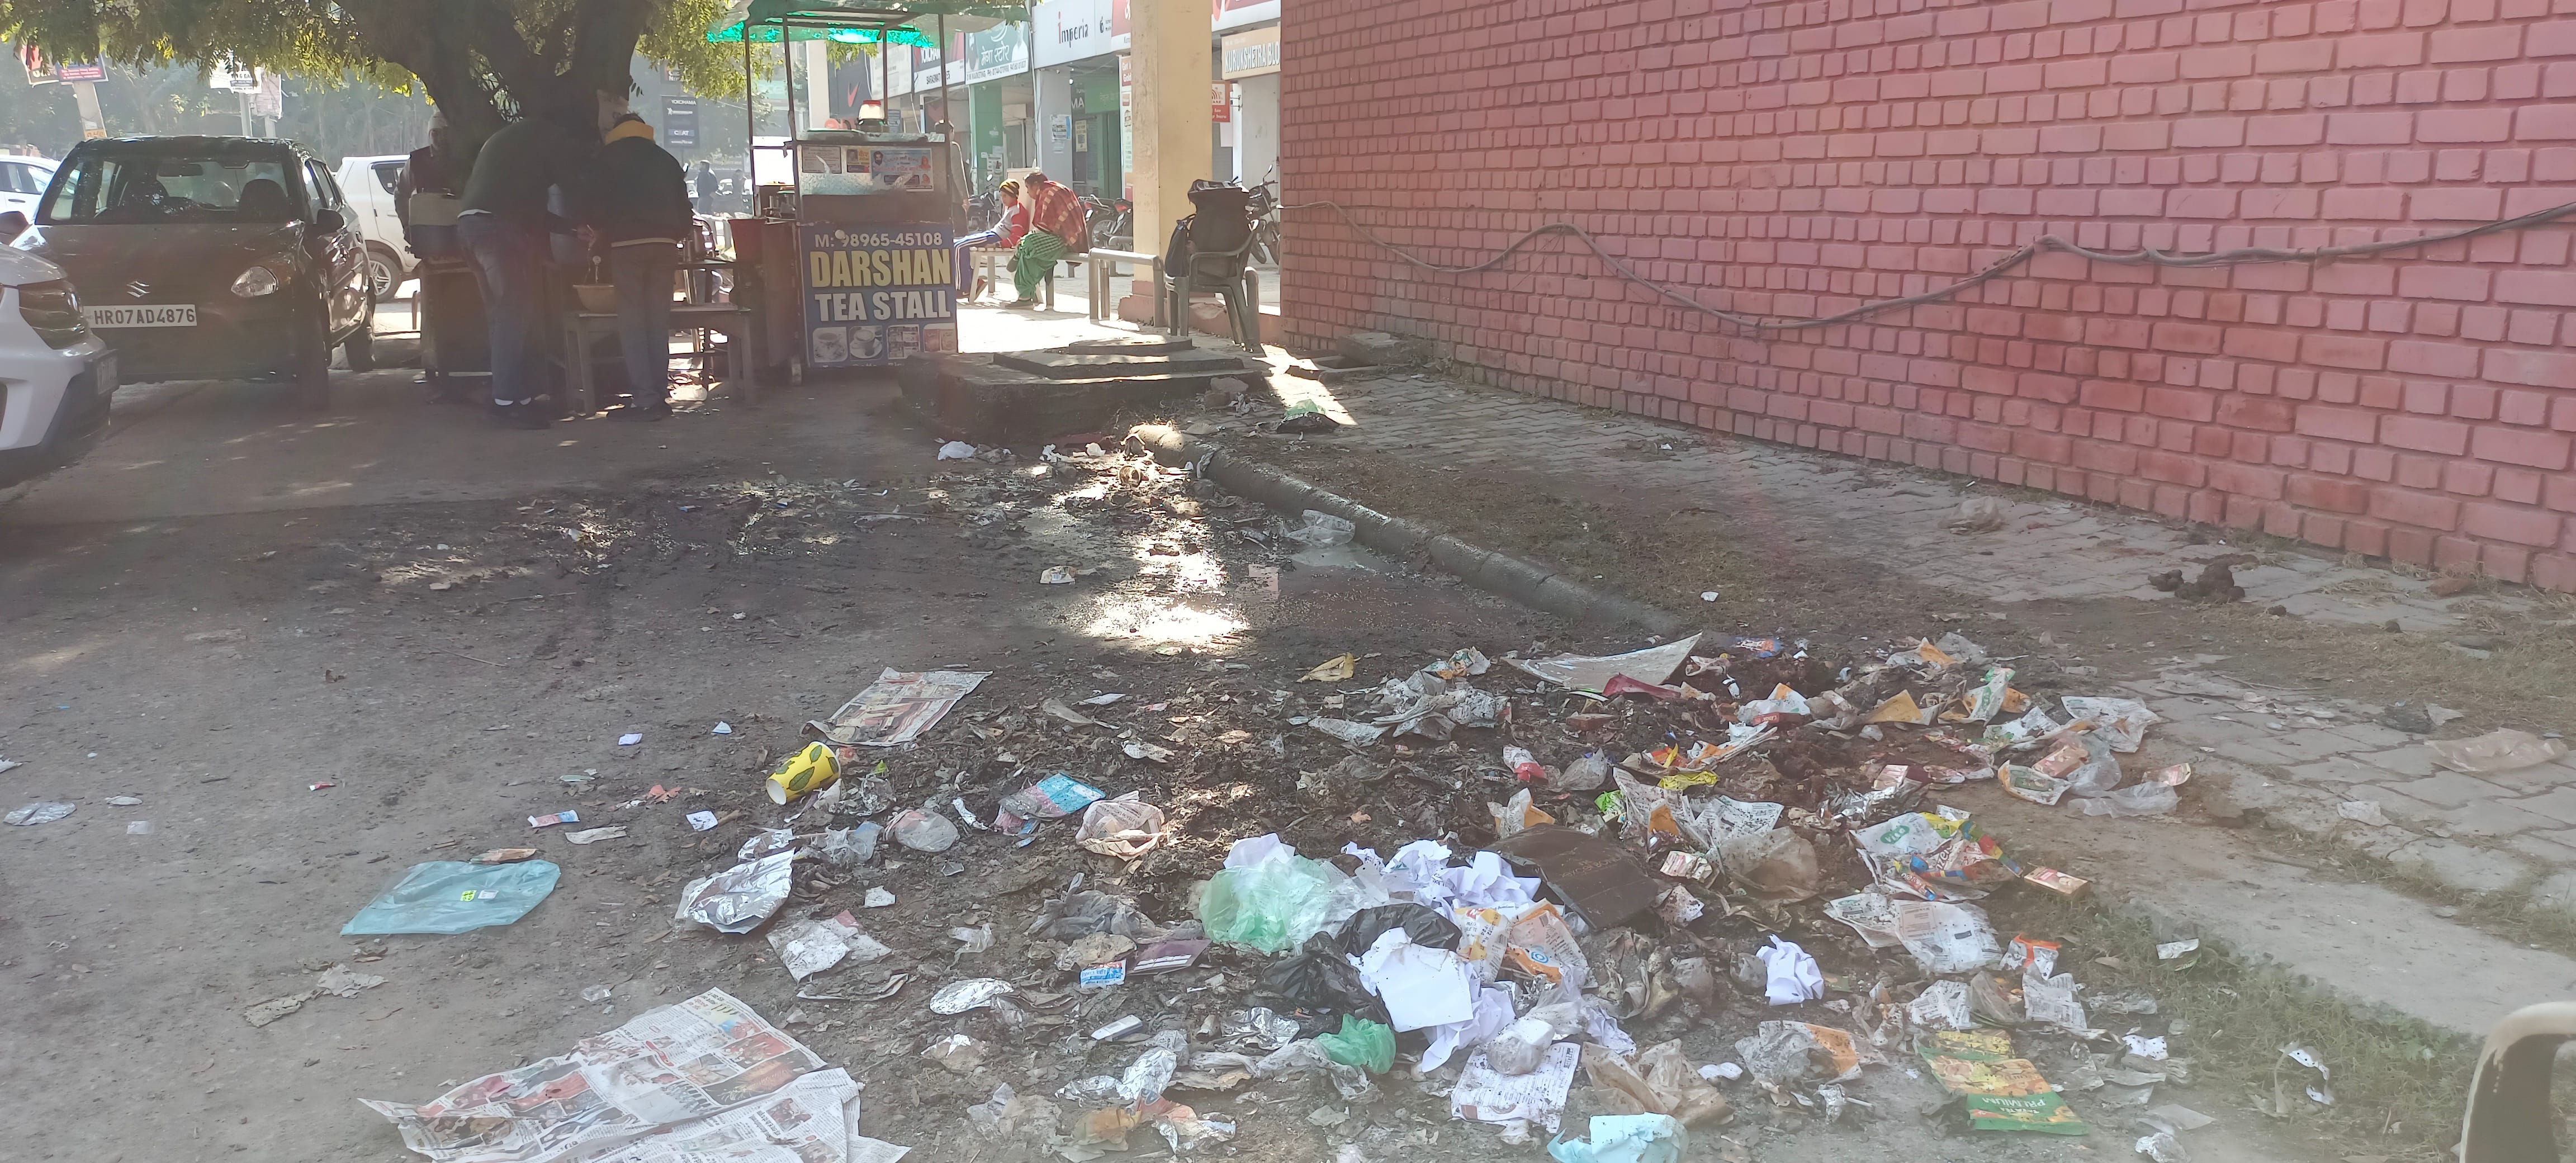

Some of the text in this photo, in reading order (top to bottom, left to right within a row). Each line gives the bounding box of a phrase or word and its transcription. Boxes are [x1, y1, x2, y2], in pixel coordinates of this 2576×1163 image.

[981, 45, 993, 66] मेगा
[995, 40, 1009, 63] स्टोर
[1225, 41, 1280, 73] KURUKSHETRA BLO
[841, 232, 943, 248] 98965-45108
[810, 249, 951, 287] DARSHAN
[94, 309, 195, 324] HR07AD4876
[815, 290, 951, 322] TEA STALL
